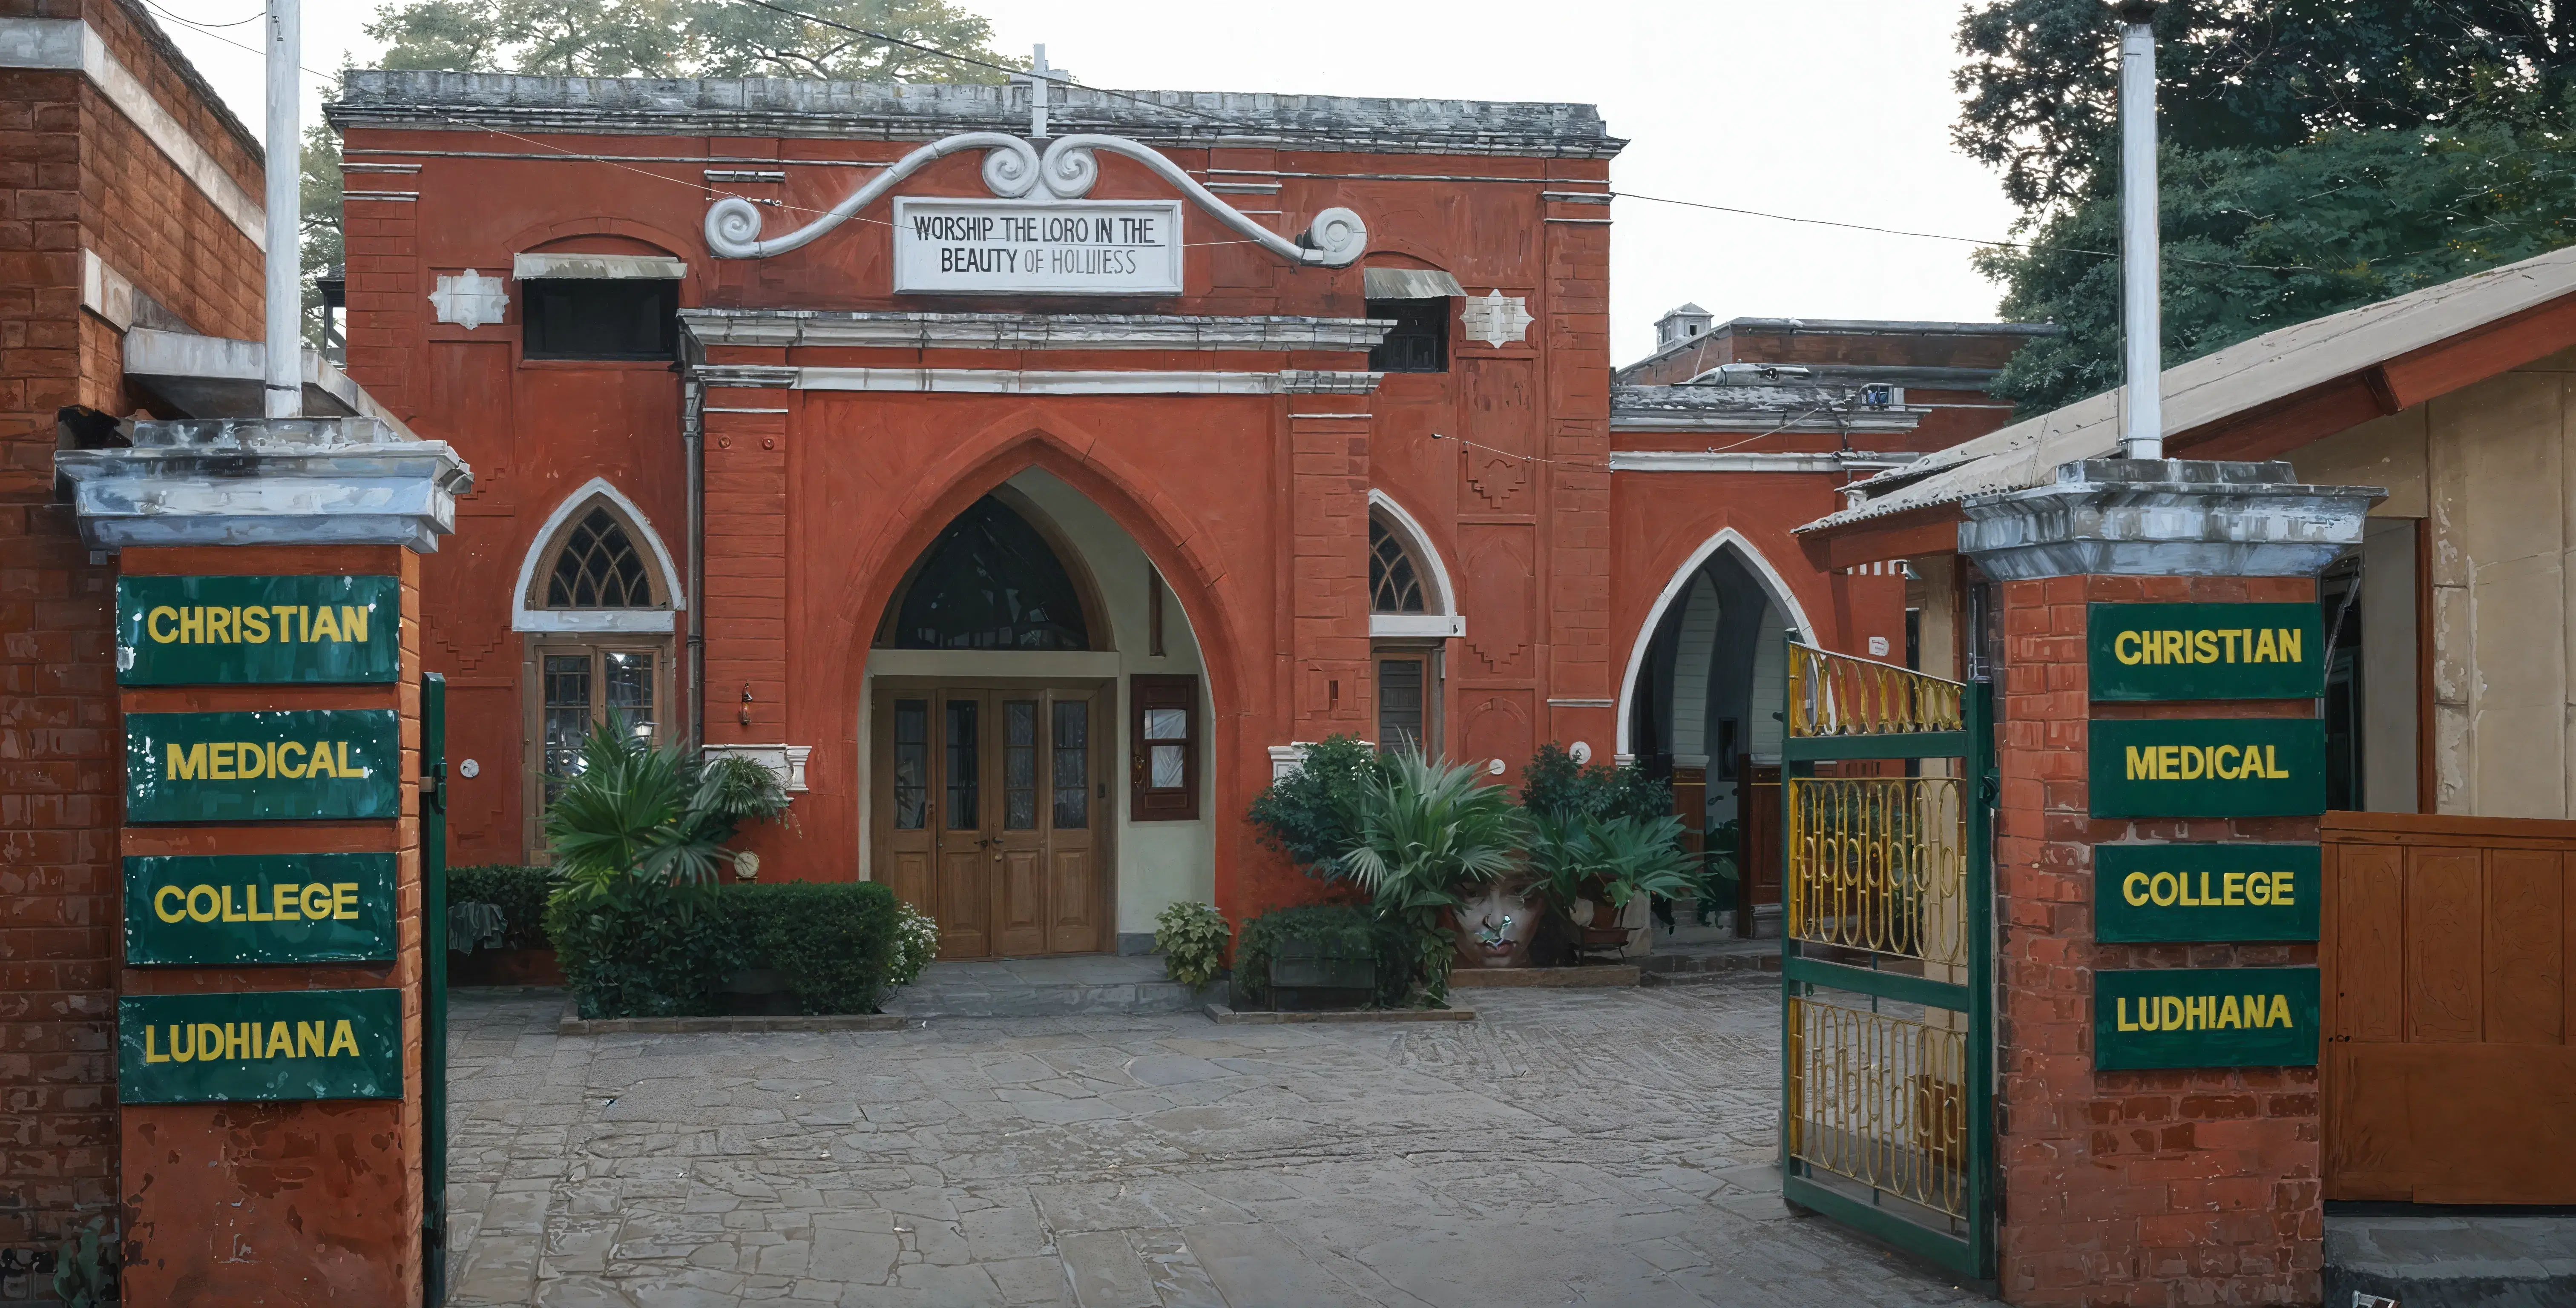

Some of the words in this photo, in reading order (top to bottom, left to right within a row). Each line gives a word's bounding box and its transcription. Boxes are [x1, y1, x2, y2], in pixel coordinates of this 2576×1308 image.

[912, 216, 993, 241] WORSHIP
[1000, 217, 1038, 242] THE
[1095, 218, 1113, 243] IN
[1119, 218, 1155, 243] THE
[941, 248, 1018, 273] BEAUTY
[1024, 249, 1044, 273] OF
[147, 605, 368, 644] CHRISTIAN
[2114, 628, 2302, 665] CHRISTIAN
[167, 741, 364, 780] MEDICAL
[2126, 744, 2289, 780] MEDICAL
[154, 882, 359, 924] COLLEGE
[2122, 871, 2294, 906] COLLEGE
[2117, 994, 2293, 1032] LUDHIANA
[145, 1019, 360, 1063] LUDHIANA
